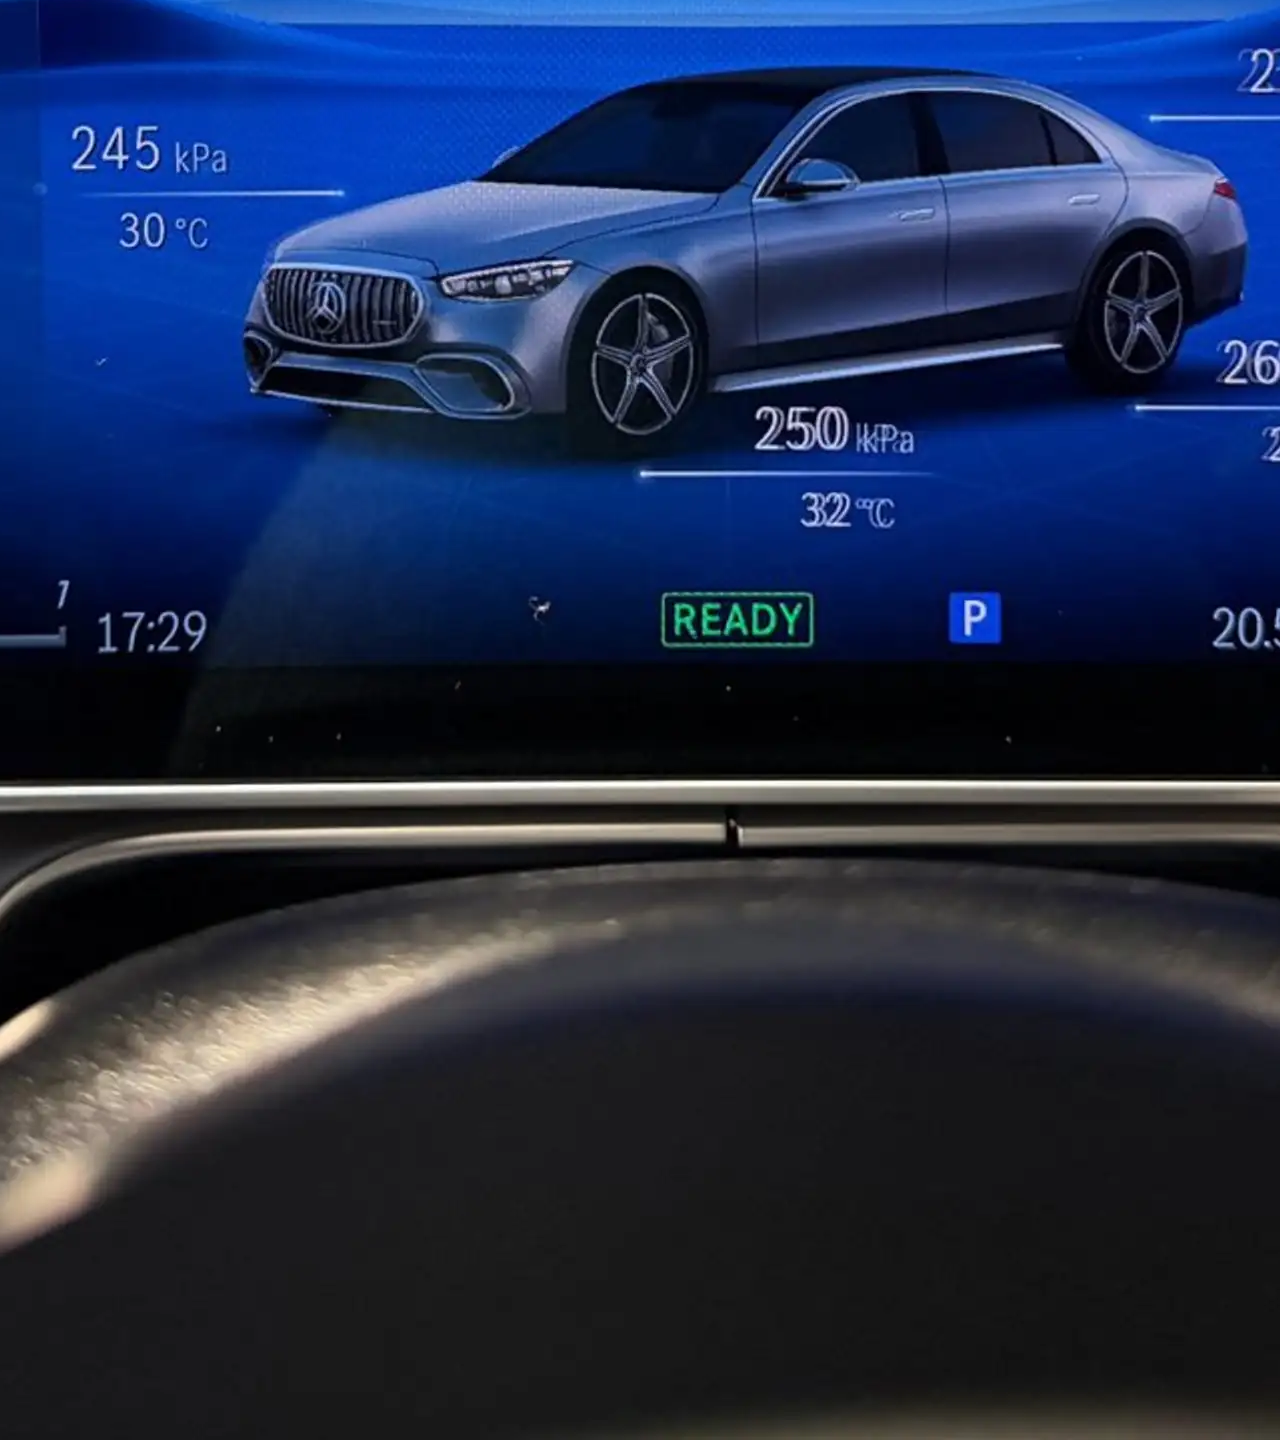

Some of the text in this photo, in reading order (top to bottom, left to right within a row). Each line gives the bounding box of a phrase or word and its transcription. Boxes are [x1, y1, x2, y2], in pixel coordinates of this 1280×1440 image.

[71, 125, 227, 173] 245 kPa
[754, 406, 850, 451] 250
[56, 581, 69, 608] 1
[96, 611, 207, 654] 17:29
[673, 602, 803, 637] READY
[963, 601, 986, 636] P
